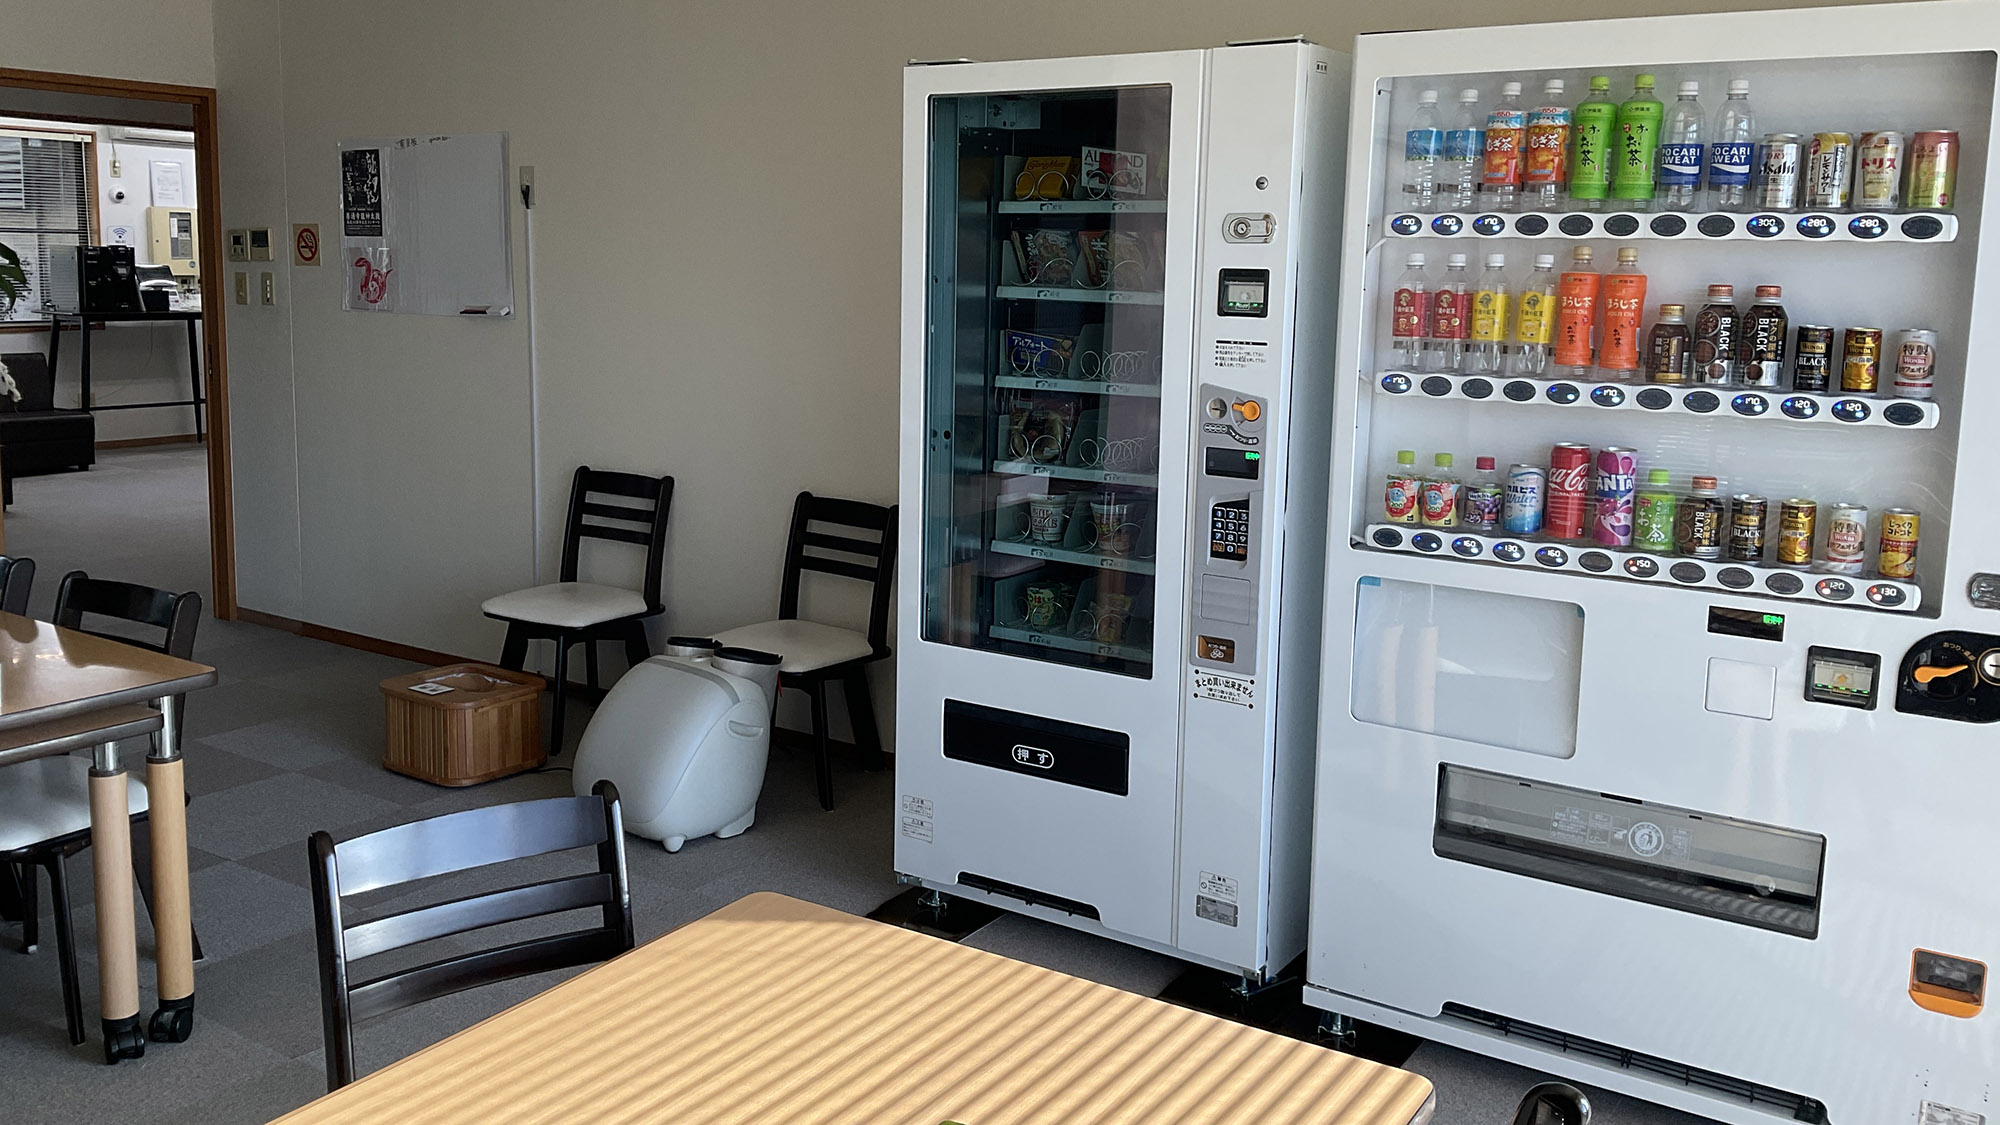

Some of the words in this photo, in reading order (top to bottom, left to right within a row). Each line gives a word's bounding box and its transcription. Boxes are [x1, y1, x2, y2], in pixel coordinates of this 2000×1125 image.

[1084, 149, 1144, 168] ALND
[1760, 160, 1795, 175] Asahi
[1861, 158, 1897, 170] トリス
[1821, 155, 1832, 193] レモンサワー
[1758, 218, 1776, 227] 300
[1807, 219, 1826, 227] 280
[1859, 219, 1879, 227] 280
[1719, 317, 1732, 351] BLACK
[1756, 318, 1770, 352] BLACK
[1012, 336, 1049, 351] アルフォート
[1798, 357, 1828, 367] BLACK
[1795, 400, 1810, 408] 120
[1846, 402, 1862, 411] 120
[1596, 474, 1634, 491] ANTA
[1506, 493, 1537, 504] Water
[1228, 511, 1235, 519] 2
[1240, 513, 1248, 521] 3
[1693, 511, 1705, 539] BLACK
[1889, 520, 1913, 529] じっくり
[1733, 529, 1761, 538] BLACK
[1887, 528, 1912, 537] コトコト
[1881, 587, 1897, 596] 130
[1195, 677, 1254, 698] まとめ買い出来ません
